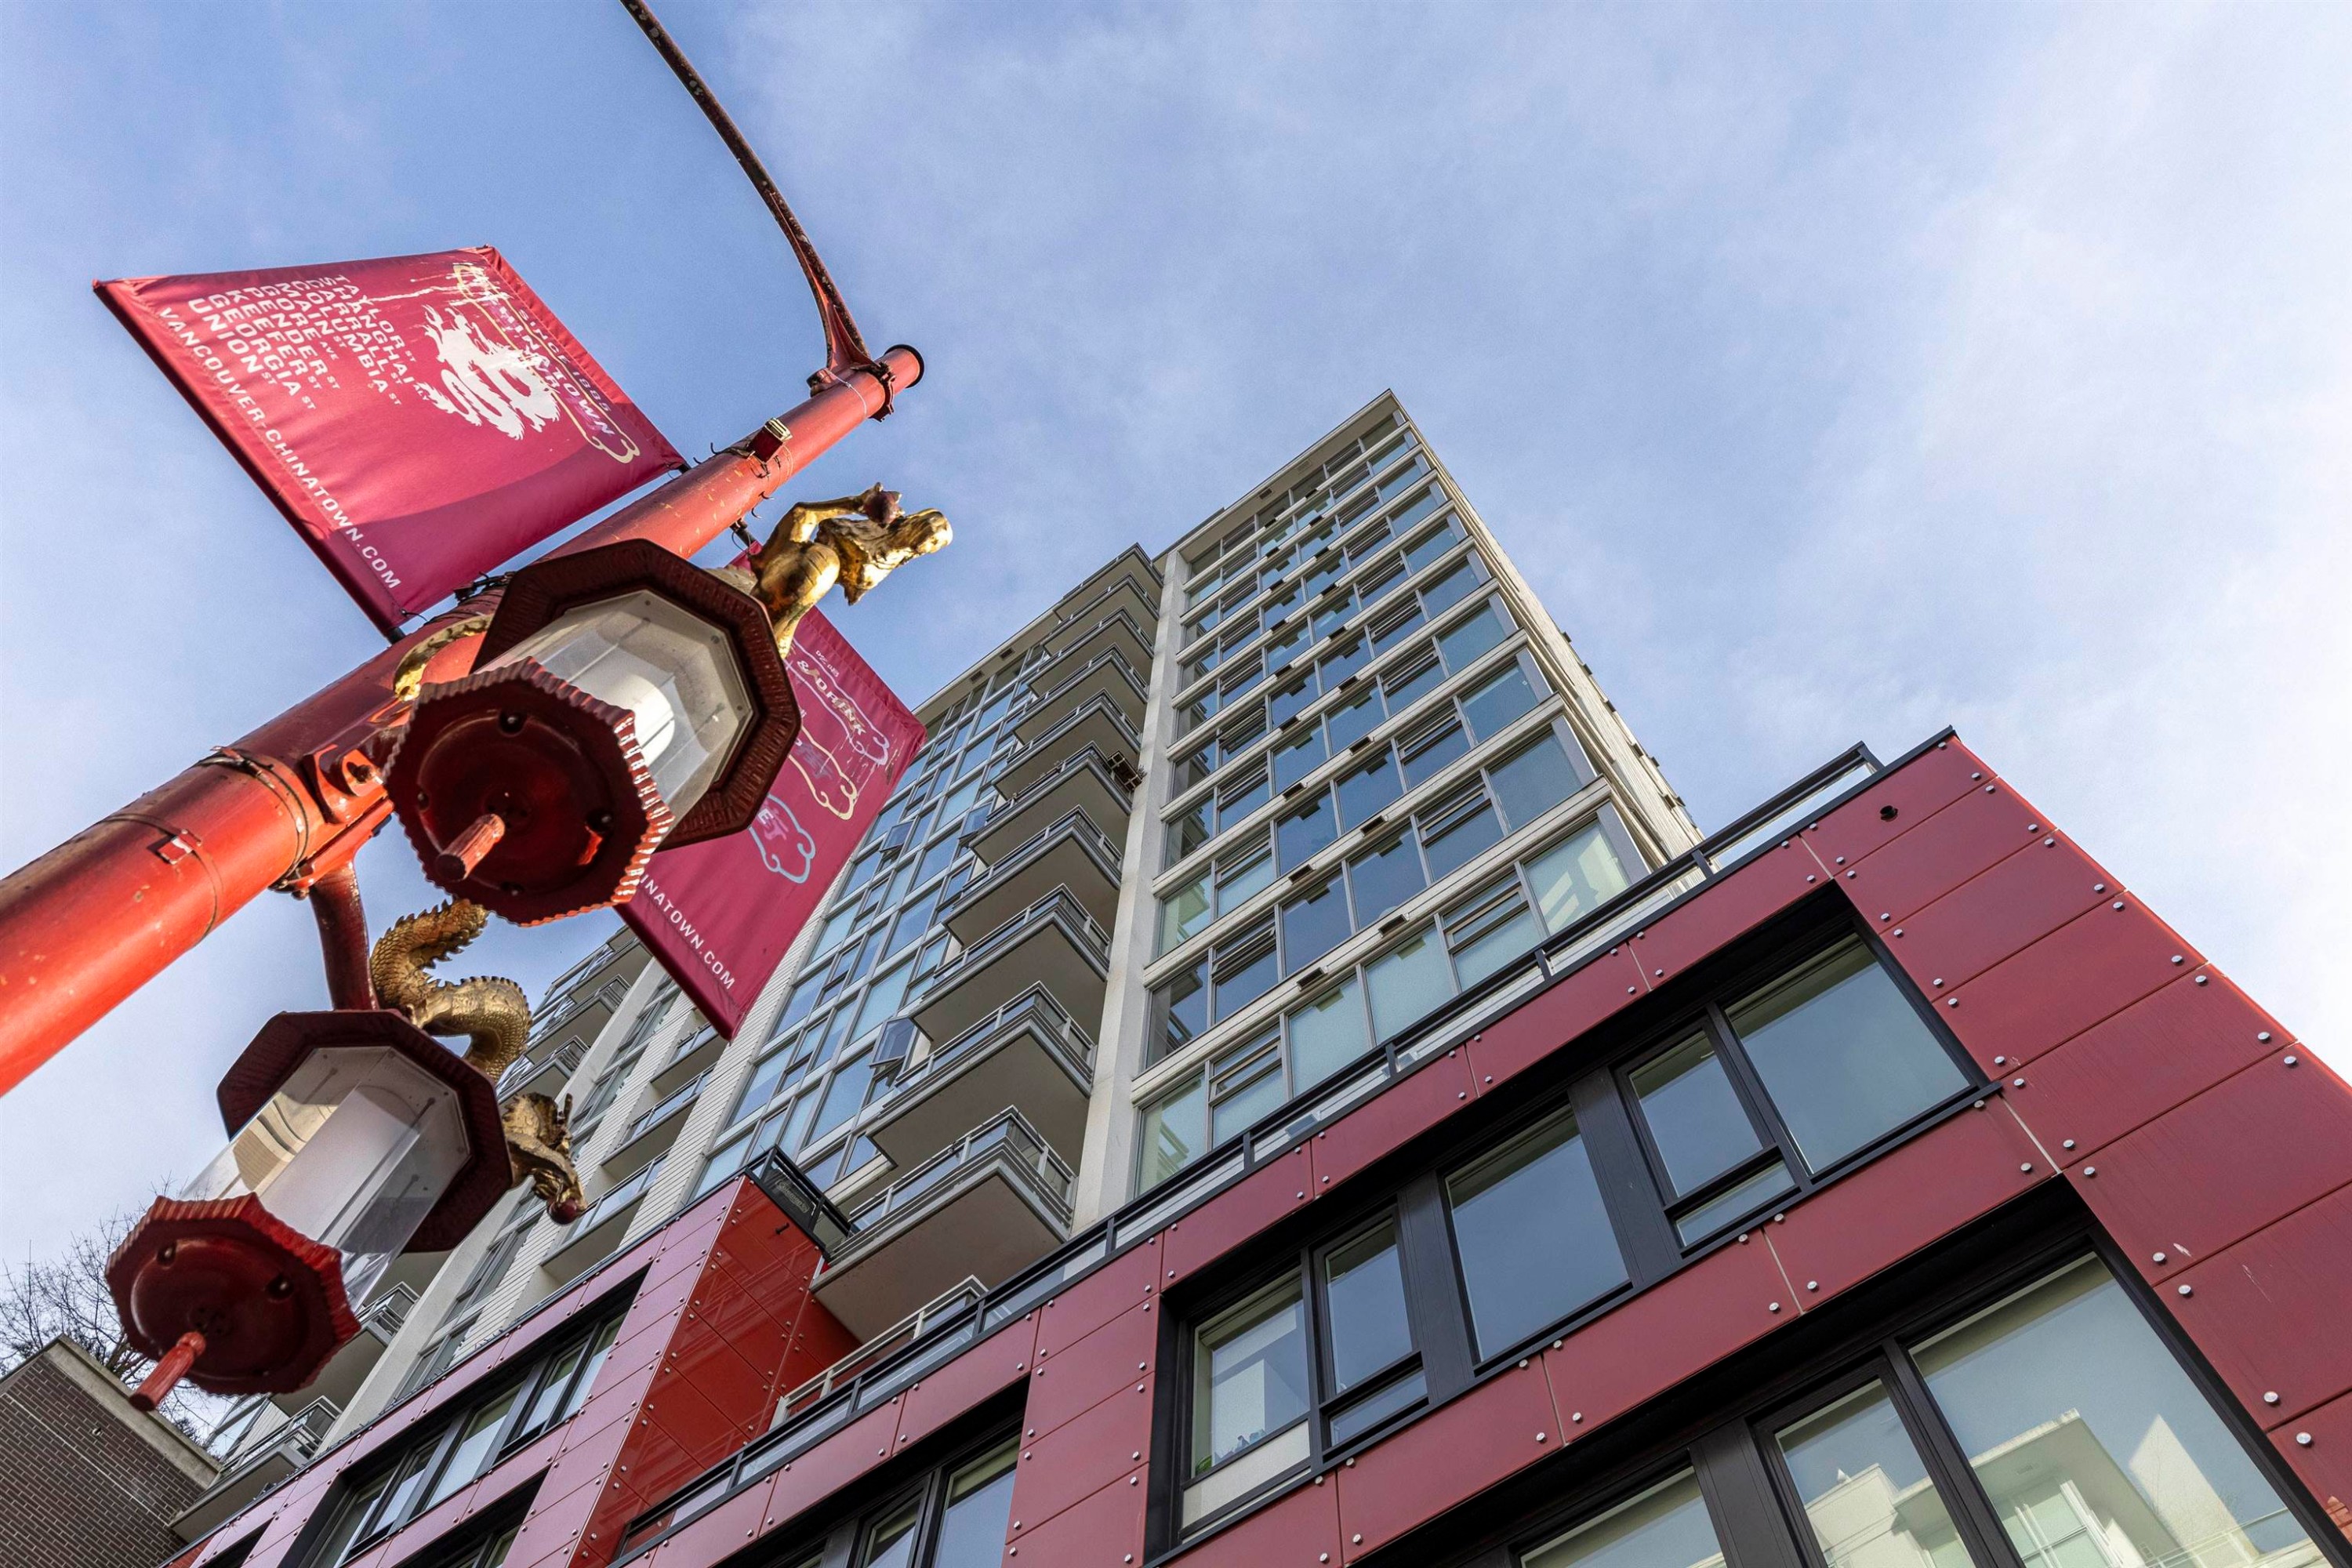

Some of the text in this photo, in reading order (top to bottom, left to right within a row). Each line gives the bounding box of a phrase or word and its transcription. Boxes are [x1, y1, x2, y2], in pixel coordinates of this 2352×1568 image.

[186, 297, 278, 385] UNION ST
[208, 294, 316, 408] GEORGIA ST
[224, 289, 323, 389] KEEFER ST
[241, 287, 341, 388] PENDER ST
[260, 285, 339, 360] GORE AVE
[275, 282, 347, 347] MAIN ST
[290, 281, 402, 405] COLUMBIA ST
[304, 279, 403, 383] CARRALL ST
[318, 277, 412, 379] SHANGHAI
[334, 274, 417, 361] TAYLOR ST
[516, 309, 571, 364] SINCE
[572, 371, 613, 412] 1885
[158, 307, 401, 587] VANCOUVER-CHINATOWN.COM
[815, 677, 866, 735] DRINK
[640, 874, 735, 989] INATOWN.COM
